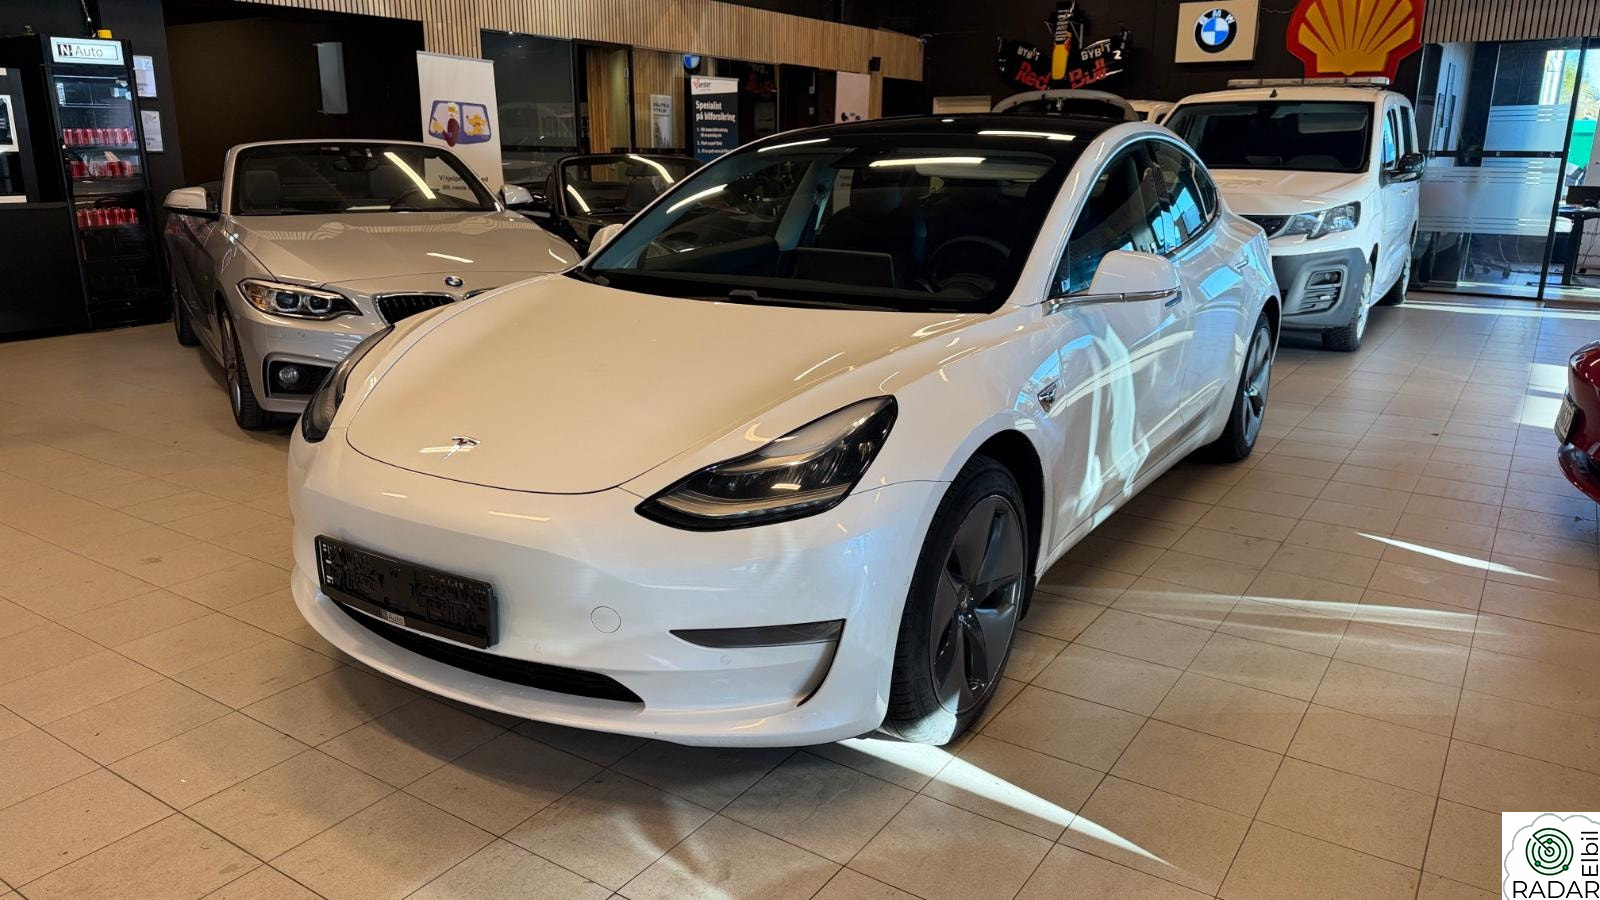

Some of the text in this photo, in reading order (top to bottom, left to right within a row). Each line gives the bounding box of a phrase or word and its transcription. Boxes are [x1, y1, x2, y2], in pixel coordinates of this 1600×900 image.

[75, 46, 104, 57] Auto
[1017, 46, 1041, 61] BYBIT
[1081, 43, 1111, 61] BYBIT
[1112, 50, 1122, 60] 2
[1015, 58, 1108, 91] Red Bull
[695, 100, 722, 111] Spesialist
[696, 112, 736, 122] på bilforsikring
[388, 612, 404, 625] Auto
